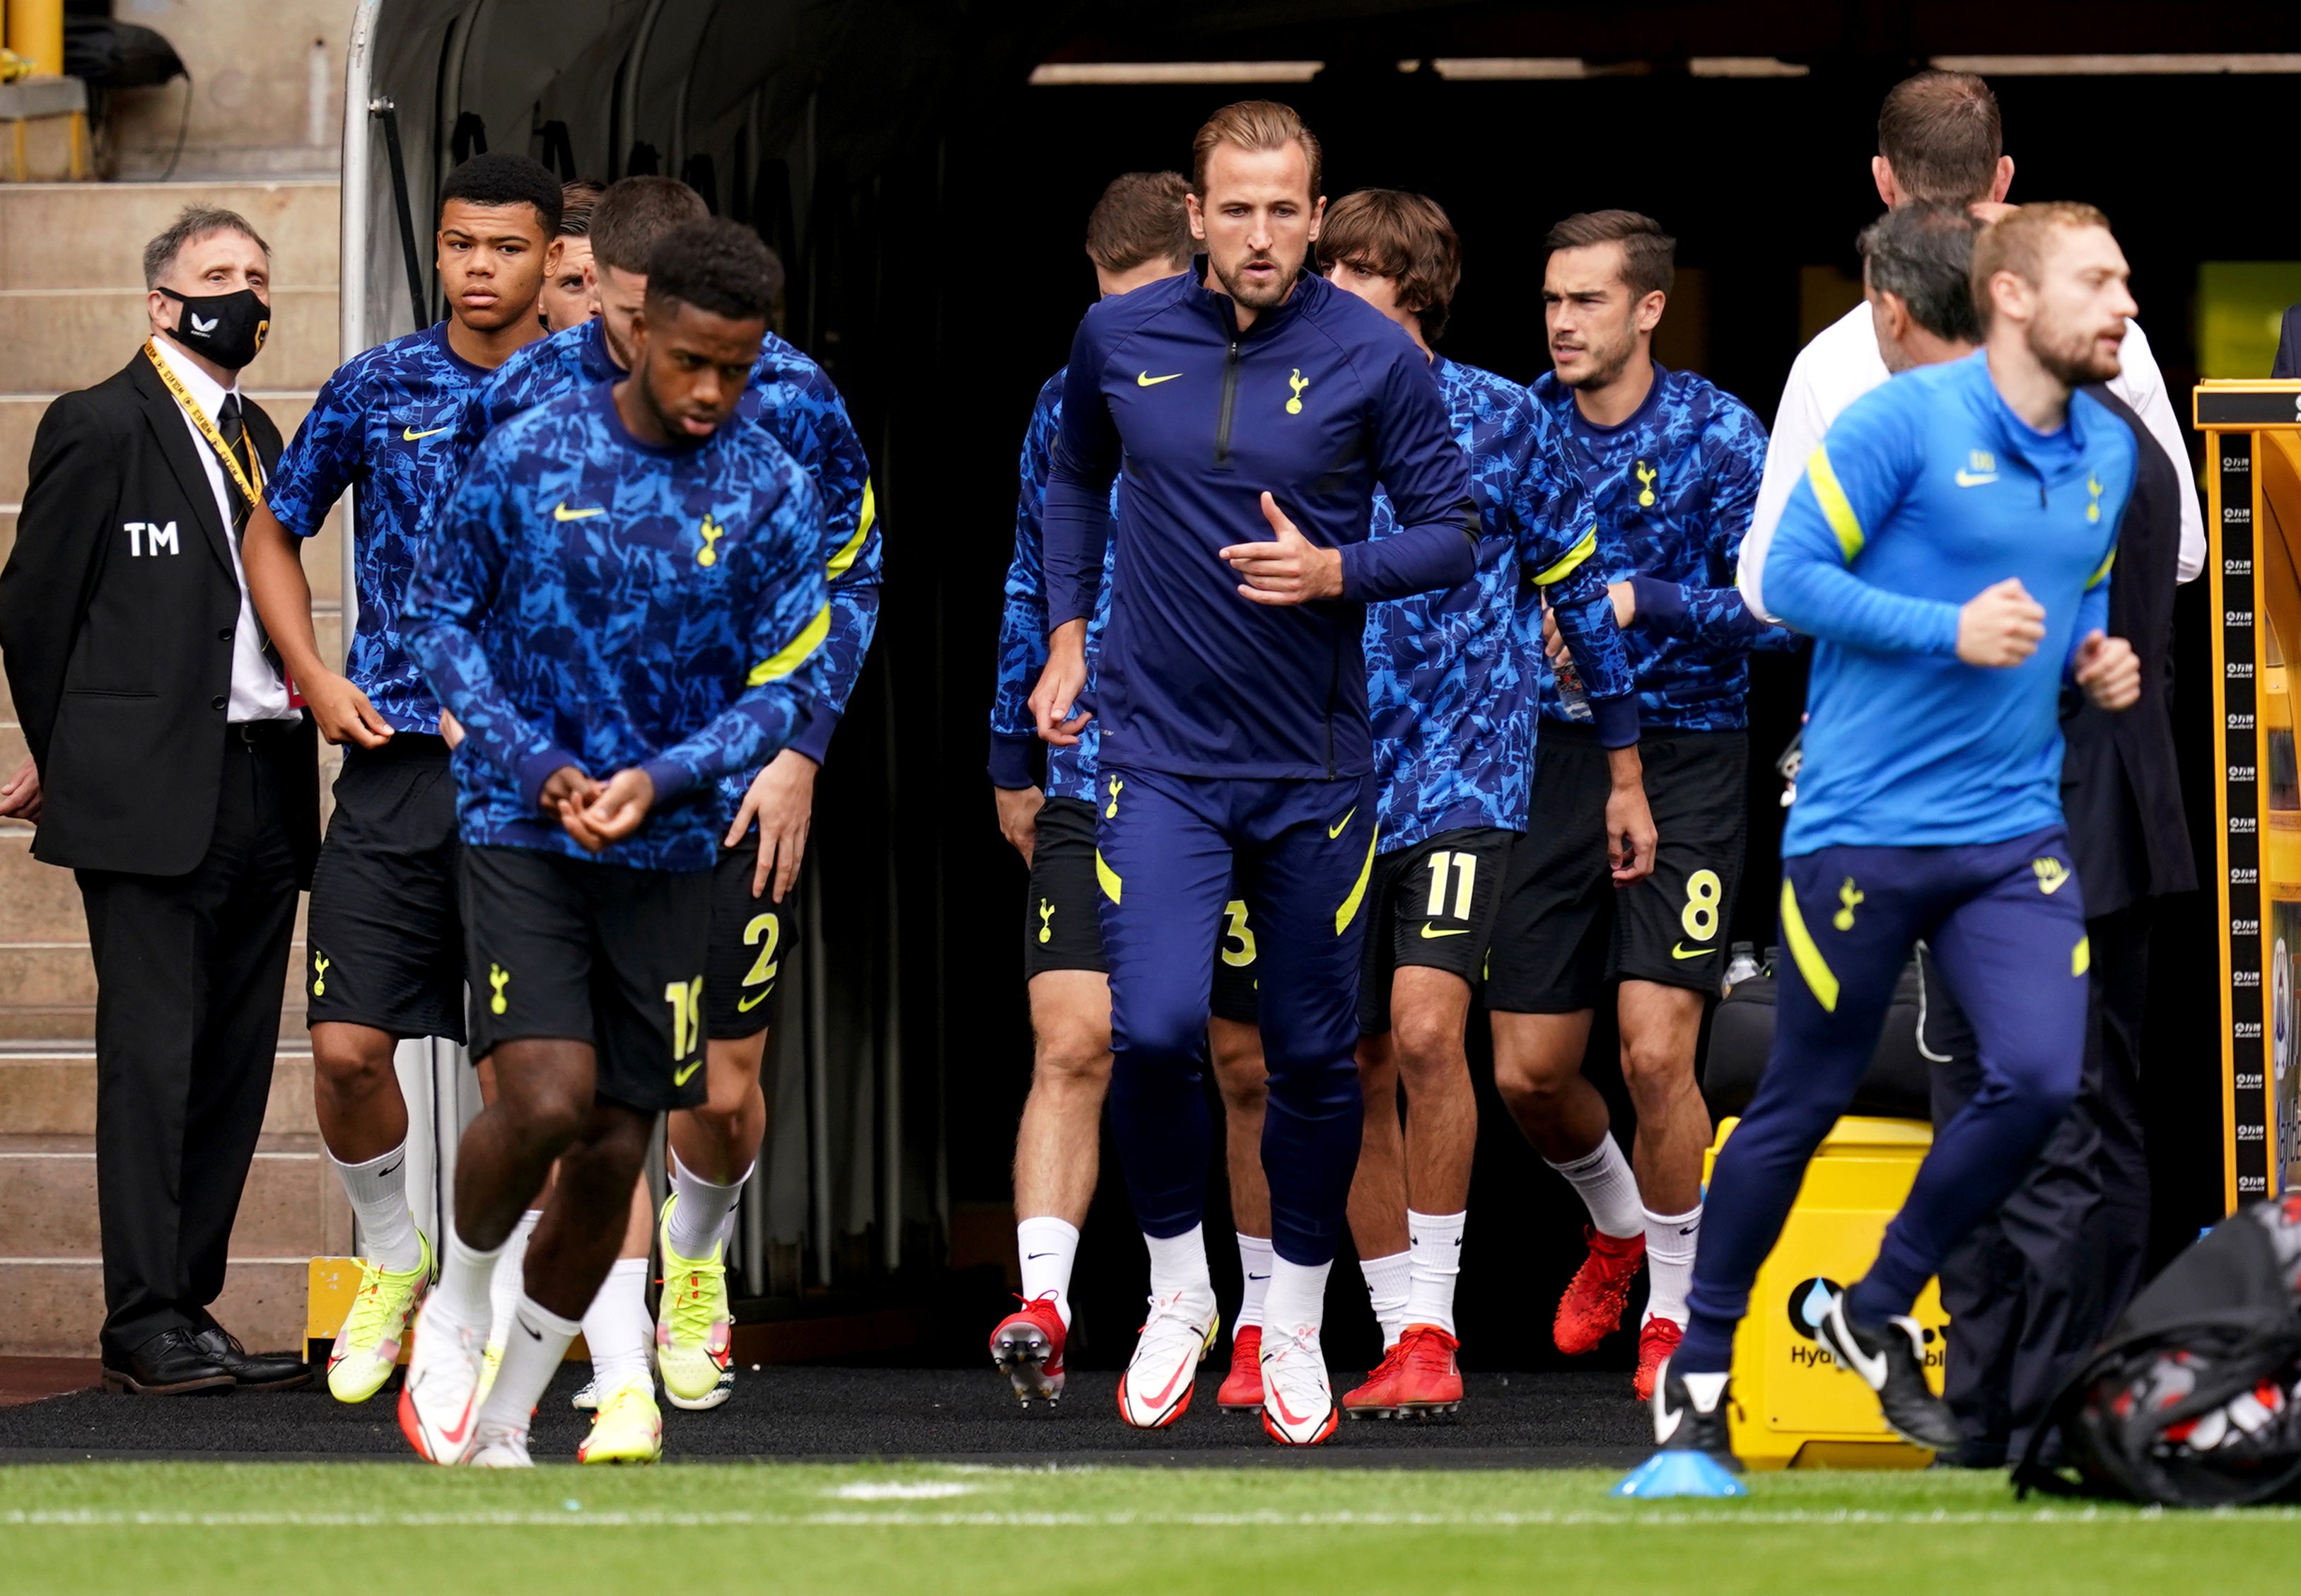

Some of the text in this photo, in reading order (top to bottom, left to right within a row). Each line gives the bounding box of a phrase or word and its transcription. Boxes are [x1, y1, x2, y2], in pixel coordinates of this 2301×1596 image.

[163, 370, 185, 396] WOLVES
[192, 409, 213, 436] WOLVES
[124, 521, 179, 557] TM
[1427, 851, 1477, 921] 11
[1682, 868, 1722, 941] 8
[742, 912, 779, 986] 2
[1221, 899, 1257, 967] 3
